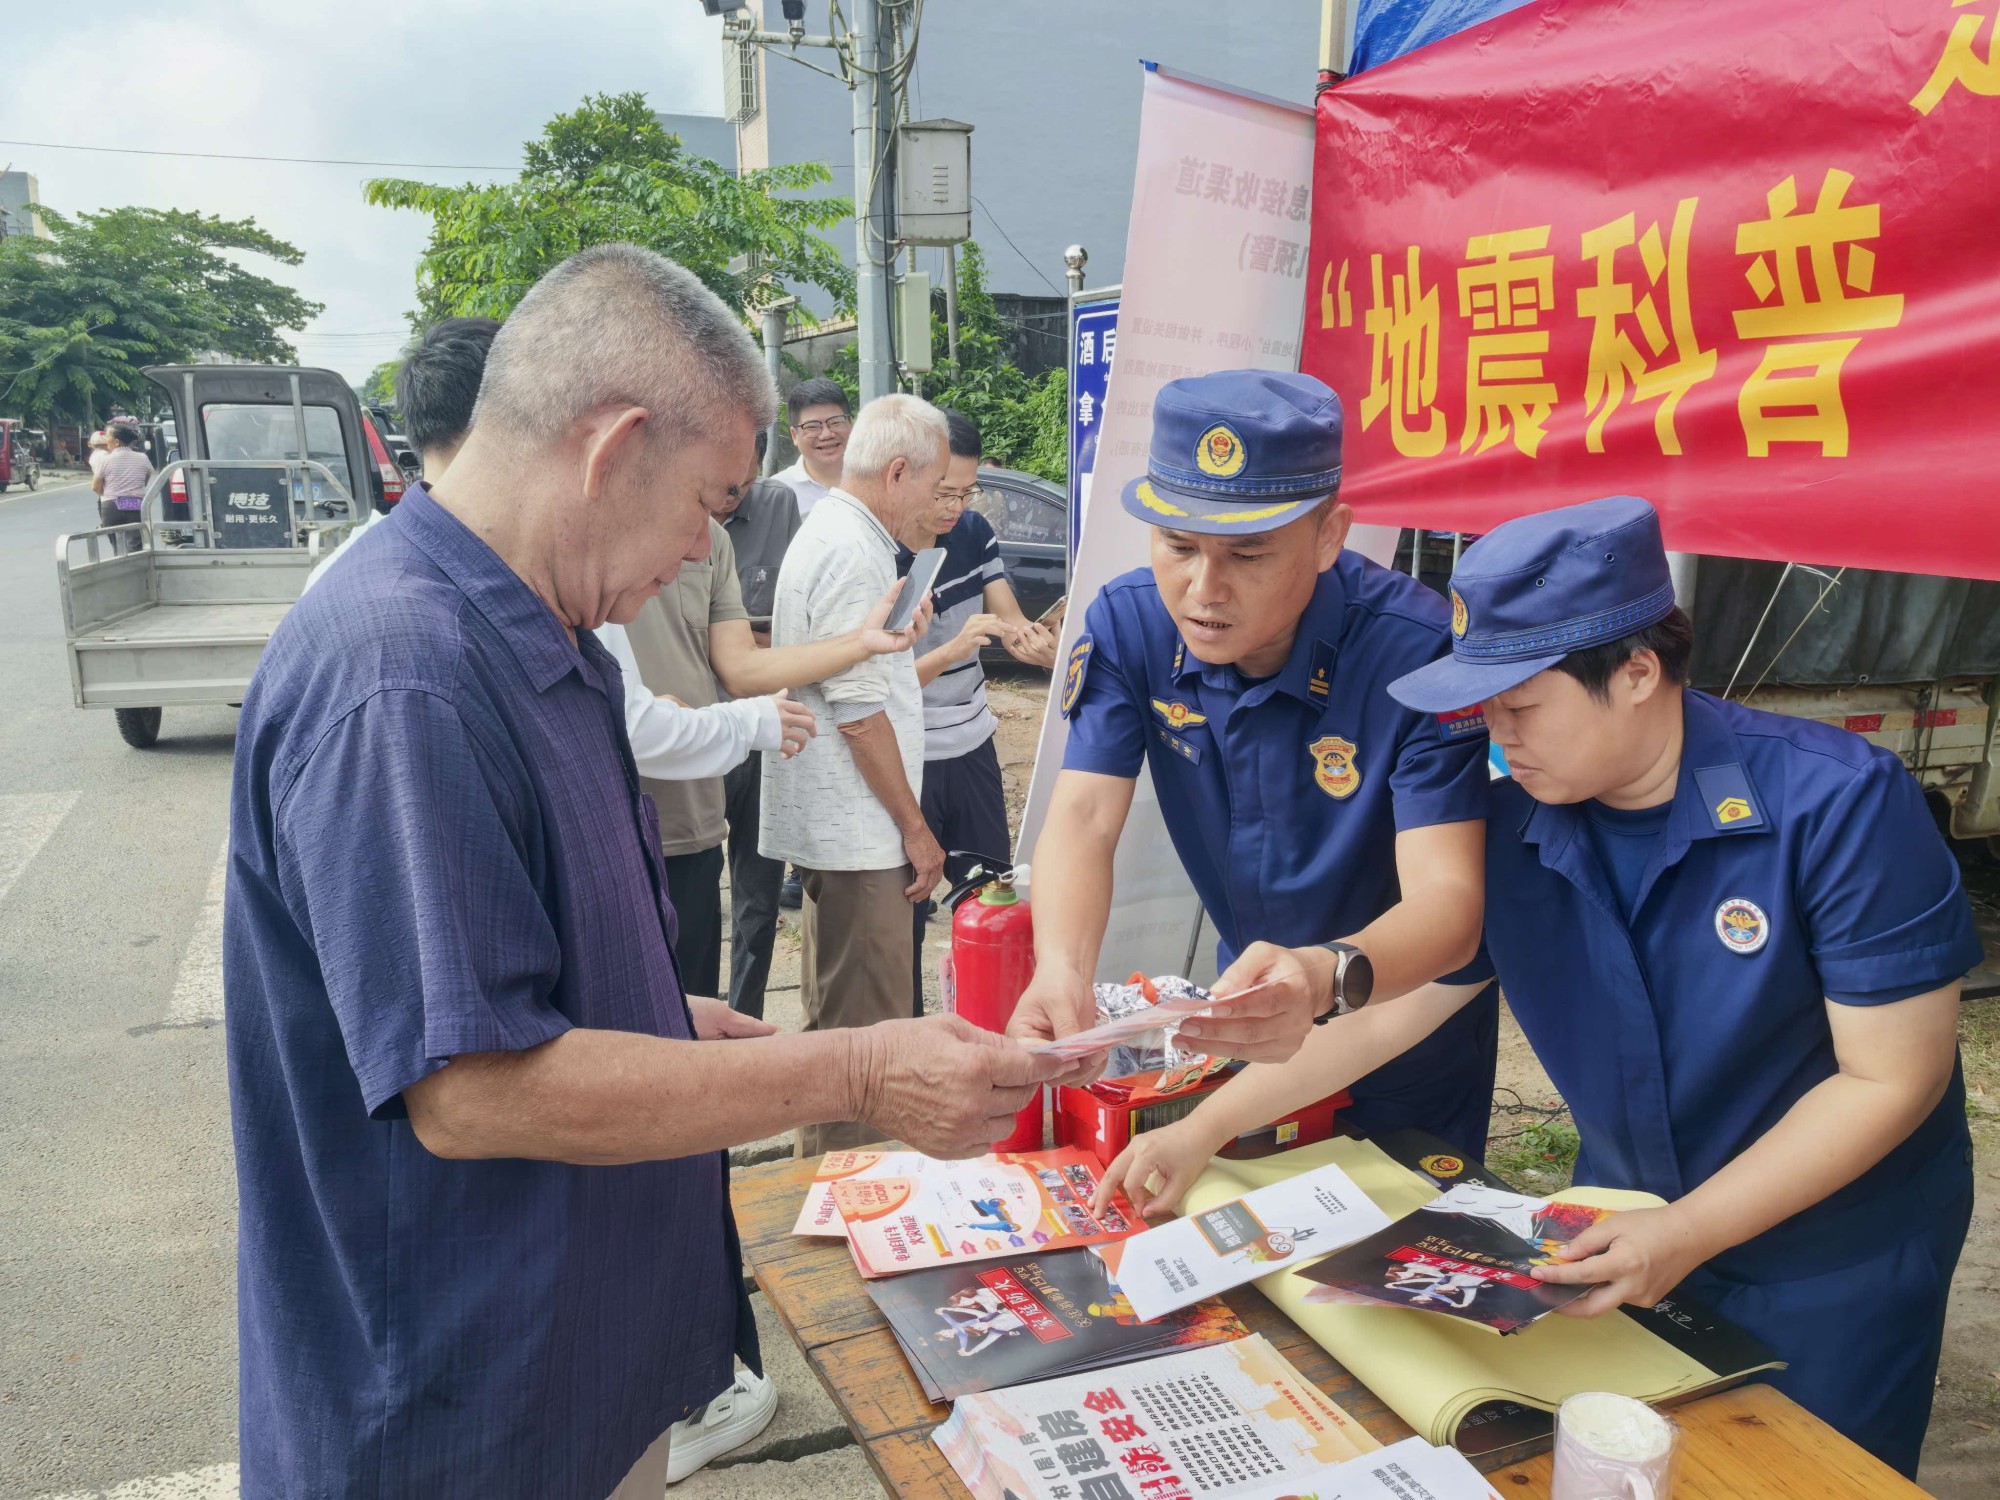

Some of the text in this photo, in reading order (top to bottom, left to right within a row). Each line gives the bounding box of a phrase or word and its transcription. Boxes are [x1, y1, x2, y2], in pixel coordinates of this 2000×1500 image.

[1320, 167, 1905, 459] “地震科普
[225, 513, 279, 524] 耐用·更长久
[228, 492, 271, 510] 博技
[990, 1278, 1057, 1330] 家庭防火
[1033, 1405, 1134, 1499] 自建房
